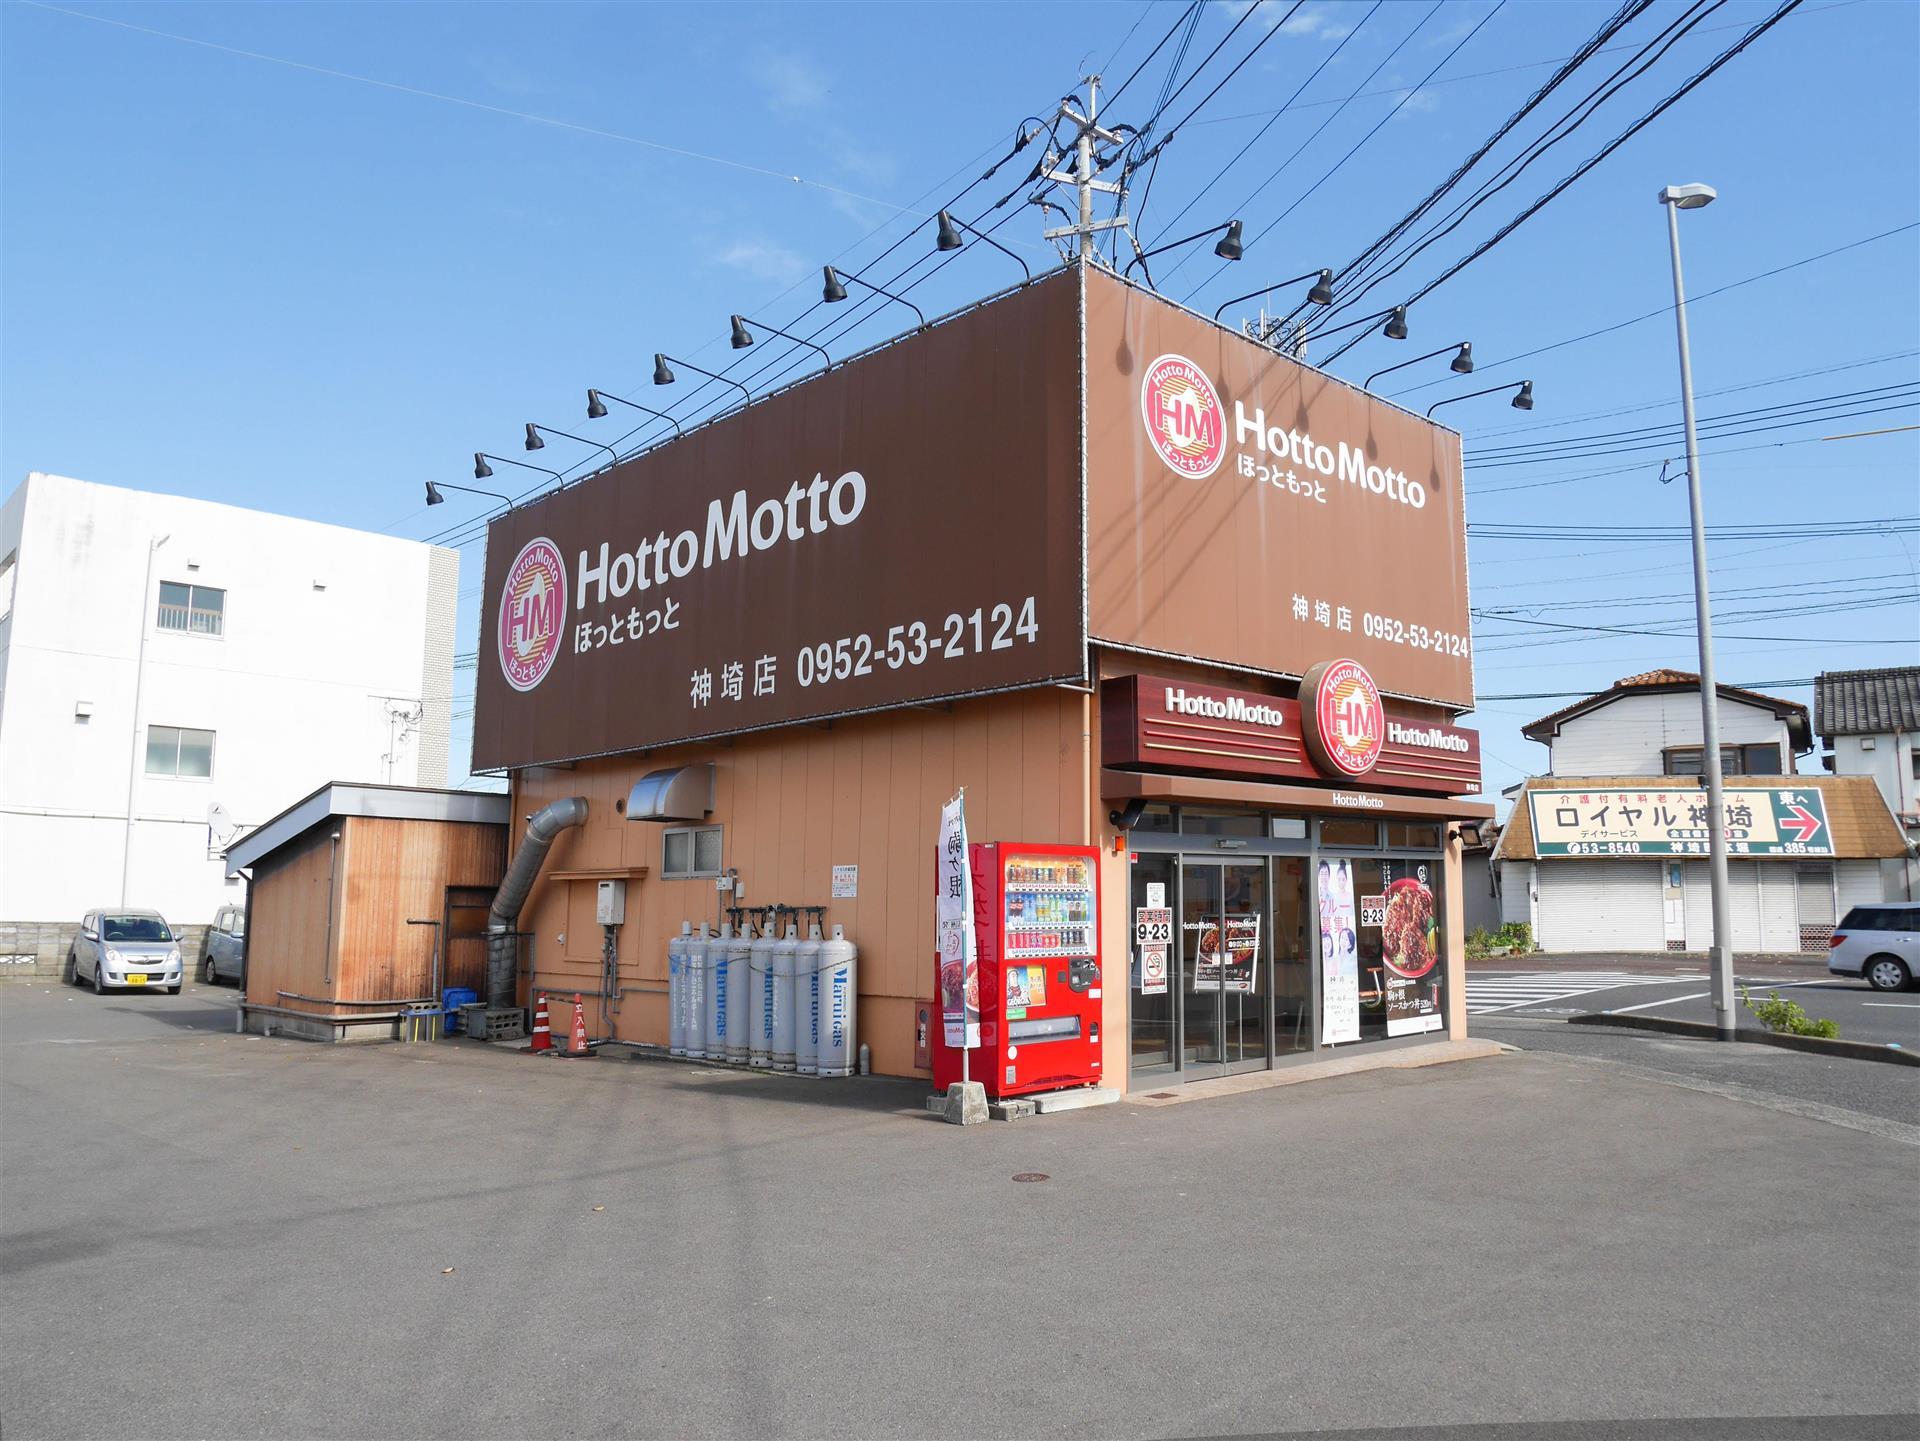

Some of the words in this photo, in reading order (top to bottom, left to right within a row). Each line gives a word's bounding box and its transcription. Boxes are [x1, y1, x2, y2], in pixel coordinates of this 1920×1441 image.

[1162, 440, 1211, 471] ほっともっと
[1237, 453, 1327, 504] ほっともっと
[573, 596, 681, 653] ほっともっと
[1291, 593, 1353, 633] 神埼店
[1363, 612, 1469, 658] 0952-53-2124
[508, 648, 551, 680] ほっともっと
[690, 654, 777, 709] 神埼店
[796, 595, 1039, 688] 0952-53-2124
[1335, 743, 1375, 767] ほっともっと
[1560, 794, 1746, 804] 介護付有料老人ホム
[1778, 791, 1809, 805] 東へ
[1580, 830, 1639, 838] デイサービス
[1582, 842, 1640, 854] 53-8540
[1319, 898, 1351, 914] クルー
